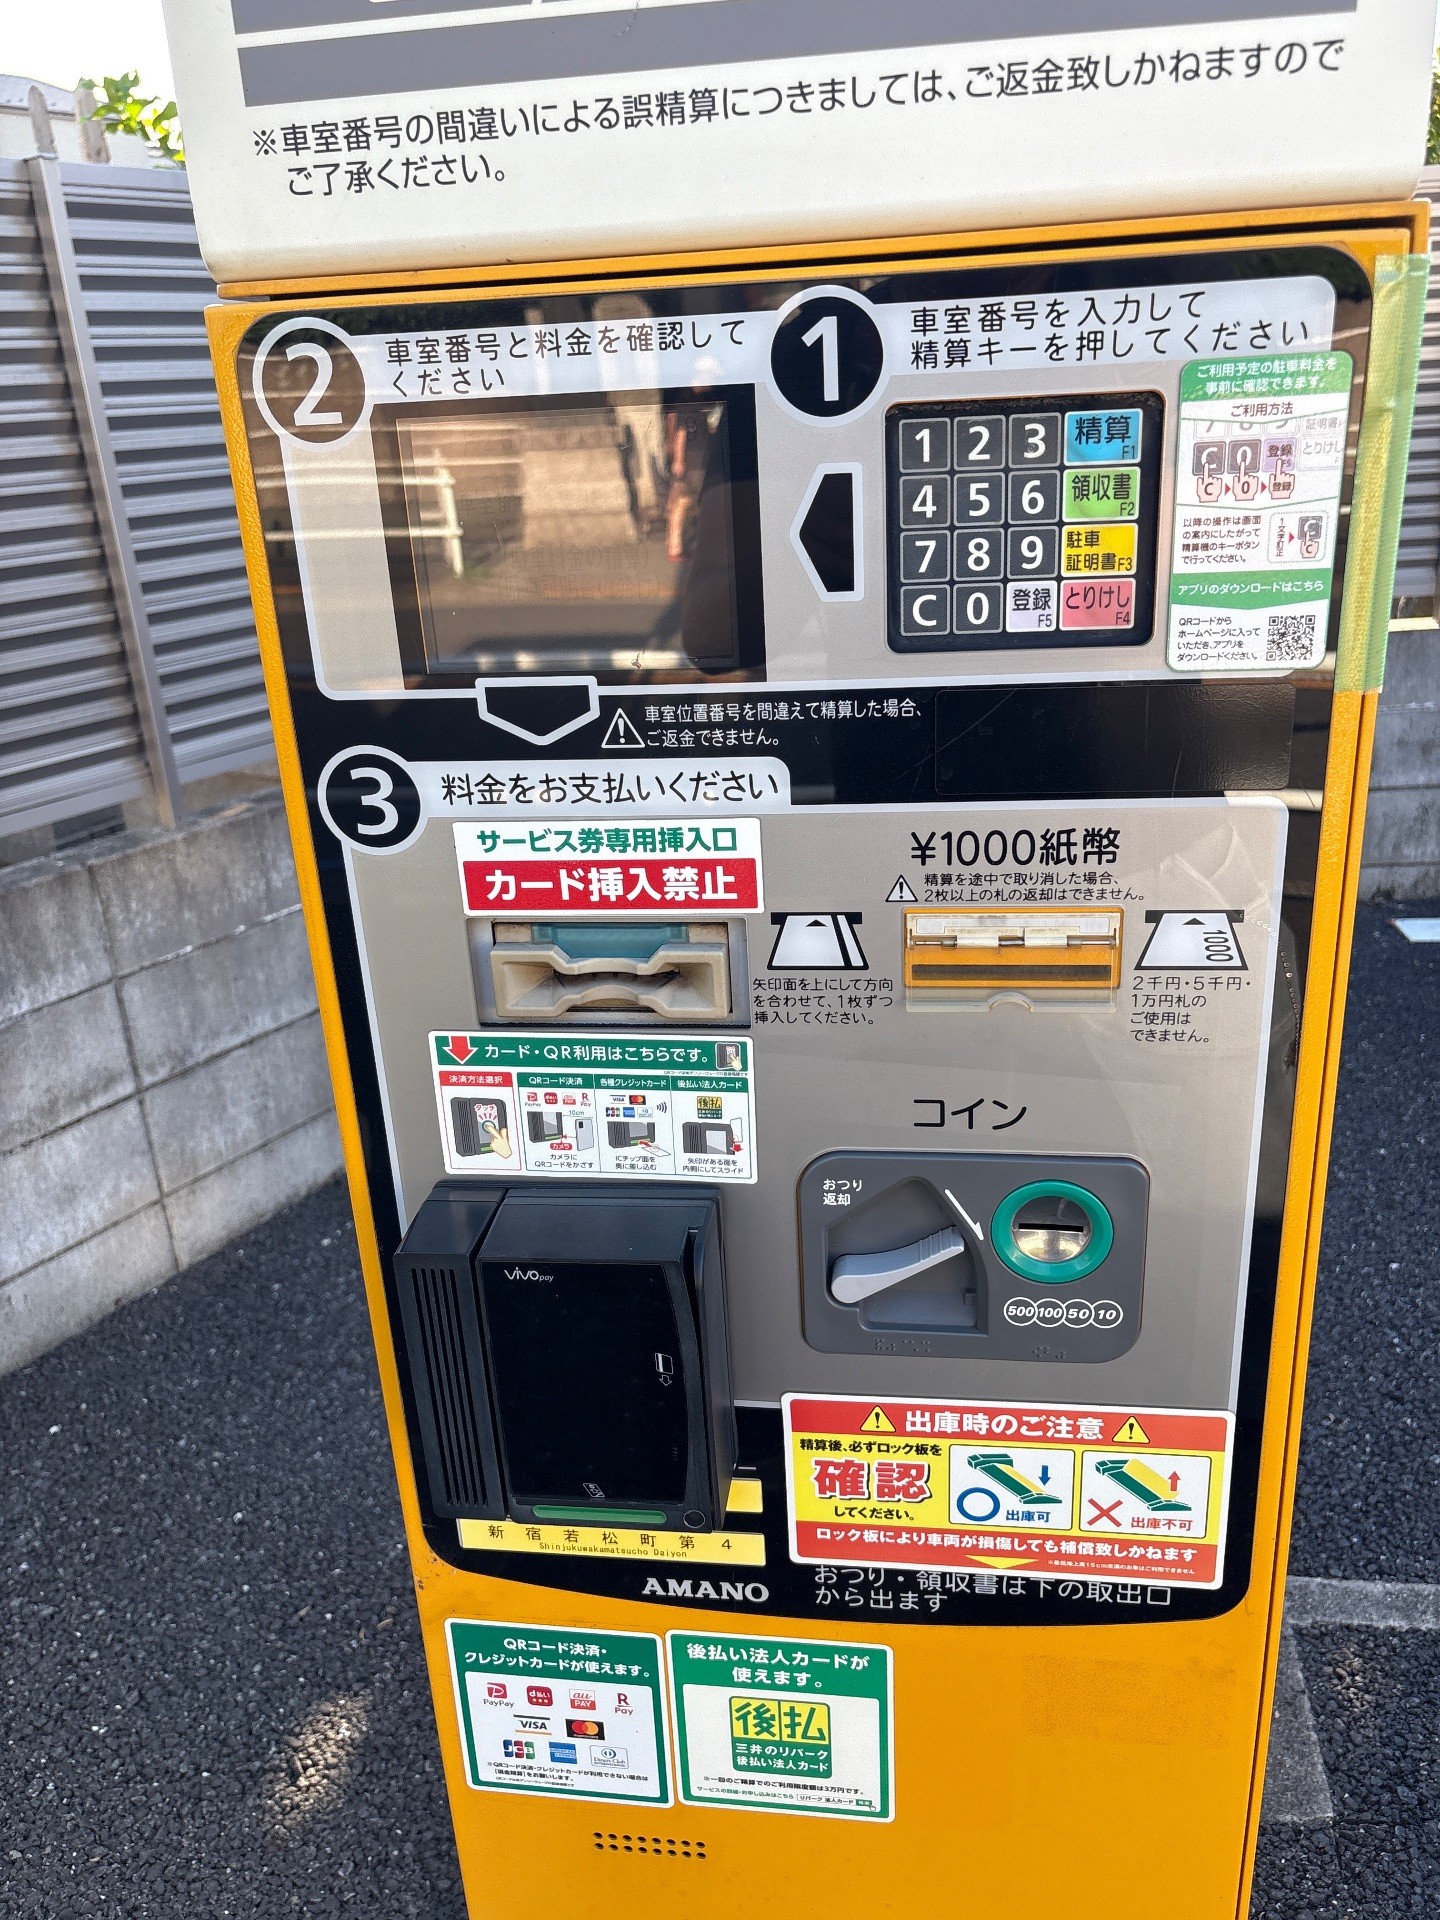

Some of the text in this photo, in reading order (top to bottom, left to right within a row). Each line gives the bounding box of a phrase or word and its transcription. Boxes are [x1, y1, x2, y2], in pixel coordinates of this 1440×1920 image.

[254, 38, 1345, 158] ※車室番号の間違いによる誤精算につきましては、ご返金致しかねますので
[288, 155, 505, 197] ご了承ください。
[911, 291, 1205, 335] 車室番号を入力して
[386, 319, 745, 366] 車室番号と料金を確認して
[911, 320, 1309, 368] 精算キーを押してください
[802, 315, 839, 402] 1
[1197, 357, 1337, 378] ご利用予定の駐車料金を
[286, 343, 343, 426] 2
[393, 367, 505, 397] ください
[1205, 378, 1325, 395] 事前に確認できます。
[1231, 402, 1293, 417] ご利用方法
[1075, 415, 1132, 445] 精算
[914, 428, 930, 462] 1
[968, 426, 990, 460] 2
[1024, 424, 1046, 458] 3
[1122, 446, 1136, 459] F1
[1267, 444, 1292, 458] 登録
[1072, 473, 1132, 502] 領収書
[1204, 482, 1214, 496] C
[1272, 481, 1292, 492] 登録
[912, 484, 937, 518] 4
[969, 482, 990, 516] 5
[1021, 480, 1045, 514] 6
[1120, 503, 1135, 516] F2
[1183, 515, 1262, 527] 以降の操作は画面
[1066, 531, 1100, 549] 駐車
[1182, 528, 1260, 540] の案内にしたがって
[967, 538, 990, 572] 8
[1020, 536, 1044, 570] 9
[1181, 541, 1260, 553] 精算機のキーボタン
[914, 540, 936, 573] 7
[1066, 554, 1132, 572] 証明書 F3
[1181, 554, 1247, 565] で行ってください。
[1065, 584, 1130, 610] とりけし
[1178, 580, 1324, 596] アプリのダウンロードはこちら
[966, 592, 990, 625] 0
[1012, 588, 1052, 612] 登録
[912, 594, 937, 626] C
[1116, 612, 1130, 625] F4
[1038, 614, 1052, 628] F5
[1178, 617, 1232, 626] QRコードから
[1178, 628, 1261, 637] ホームページに入って
[1177, 640, 1244, 649] いただき、アプリを
[1176, 652, 1258, 662] ダウンロードください。
[644, 698, 923, 723] 車室位置番号を間違えて精算した場合、
[647, 728, 779, 748] ご返金できません。
[441, 770, 777, 806] 料金をお支払いください
[350, 766, 399, 835] 3
[477, 826, 737, 853] サービス券専用挿入口
[911, 827, 1121, 866] ¥1000紙幣
[485, 866, 738, 902] カード挿入禁止
[924, 871, 1122, 887] 精算を途中で取り消した場合、
[924, 885, 1145, 903] 2枚以上の札の返却はできません。
[1202, 930, 1233, 963] 1000
[752, 977, 893, 993] 矢印面を上にして方向
[753, 993, 893, 1009] を合わせて、1枚ずつ
[1132, 992, 1206, 1008] 1万円札の
[754, 1010, 876, 1025] 挿入してください。
[1130, 1011, 1191, 1026] ご使用は
[1130, 1028, 1210, 1043] できません。
[484, 1044, 708, 1062] カード・QR利用はこちらです。
[449, 1075, 504, 1084] 決済方法選択
[529, 1076, 583, 1086] QRコード決済
[600, 1078, 667, 1088] 各種クレジットカード
[677, 1080, 742, 1089] 後払い法人カード
[913, 1098, 1027, 1130] コイン
[822, 1178, 862, 1192] おつり
[823, 1192, 851, 1206] 返却
[1008, 1305, 1116, 1320] 500 100 50 10
[905, 1410, 1104, 1440] 出庫時のご注意
[800, 1438, 942, 1456] 精算後、必ずロック板を
[813, 1458, 930, 1501] 確認
[834, 1506, 914, 1521] してください。
[1006, 1510, 1050, 1523] 出庫可
[1130, 1517, 1193, 1532] 出庫不可
[488, 1525, 732, 1550] 新宿若松町第4
[816, 1528, 1198, 1562] ロック板により車両が損傷しても補償致しかねます
[539, 1542, 687, 1558] Shinjukuwakamatsucho Daiyon
[642, 1578, 770, 1602] AMANO
[814, 1565, 1172, 1606] おつり・領収書は下の取出口
[815, 1585, 948, 1612] から出ます
[503, 1638, 607, 1658] QRコード決済・
[686, 1642, 870, 1670] 後払い法人カードが
[464, 1652, 650, 1678] クレジットカードが使えます。
[732, 1666, 822, 1688] 使えます。
[483, 1698, 514, 1708] PayPay
[574, 1700, 592, 1708] PAY
[616, 1692, 630, 1704] R
[614, 1706, 634, 1716] Pay
[518, 1720, 548, 1730] VISA
[734, 1701, 827, 1742] 後払
[736, 1743, 828, 1758] 三井のリパーク
[736, 1756, 828, 1772] 後払い法人カード
